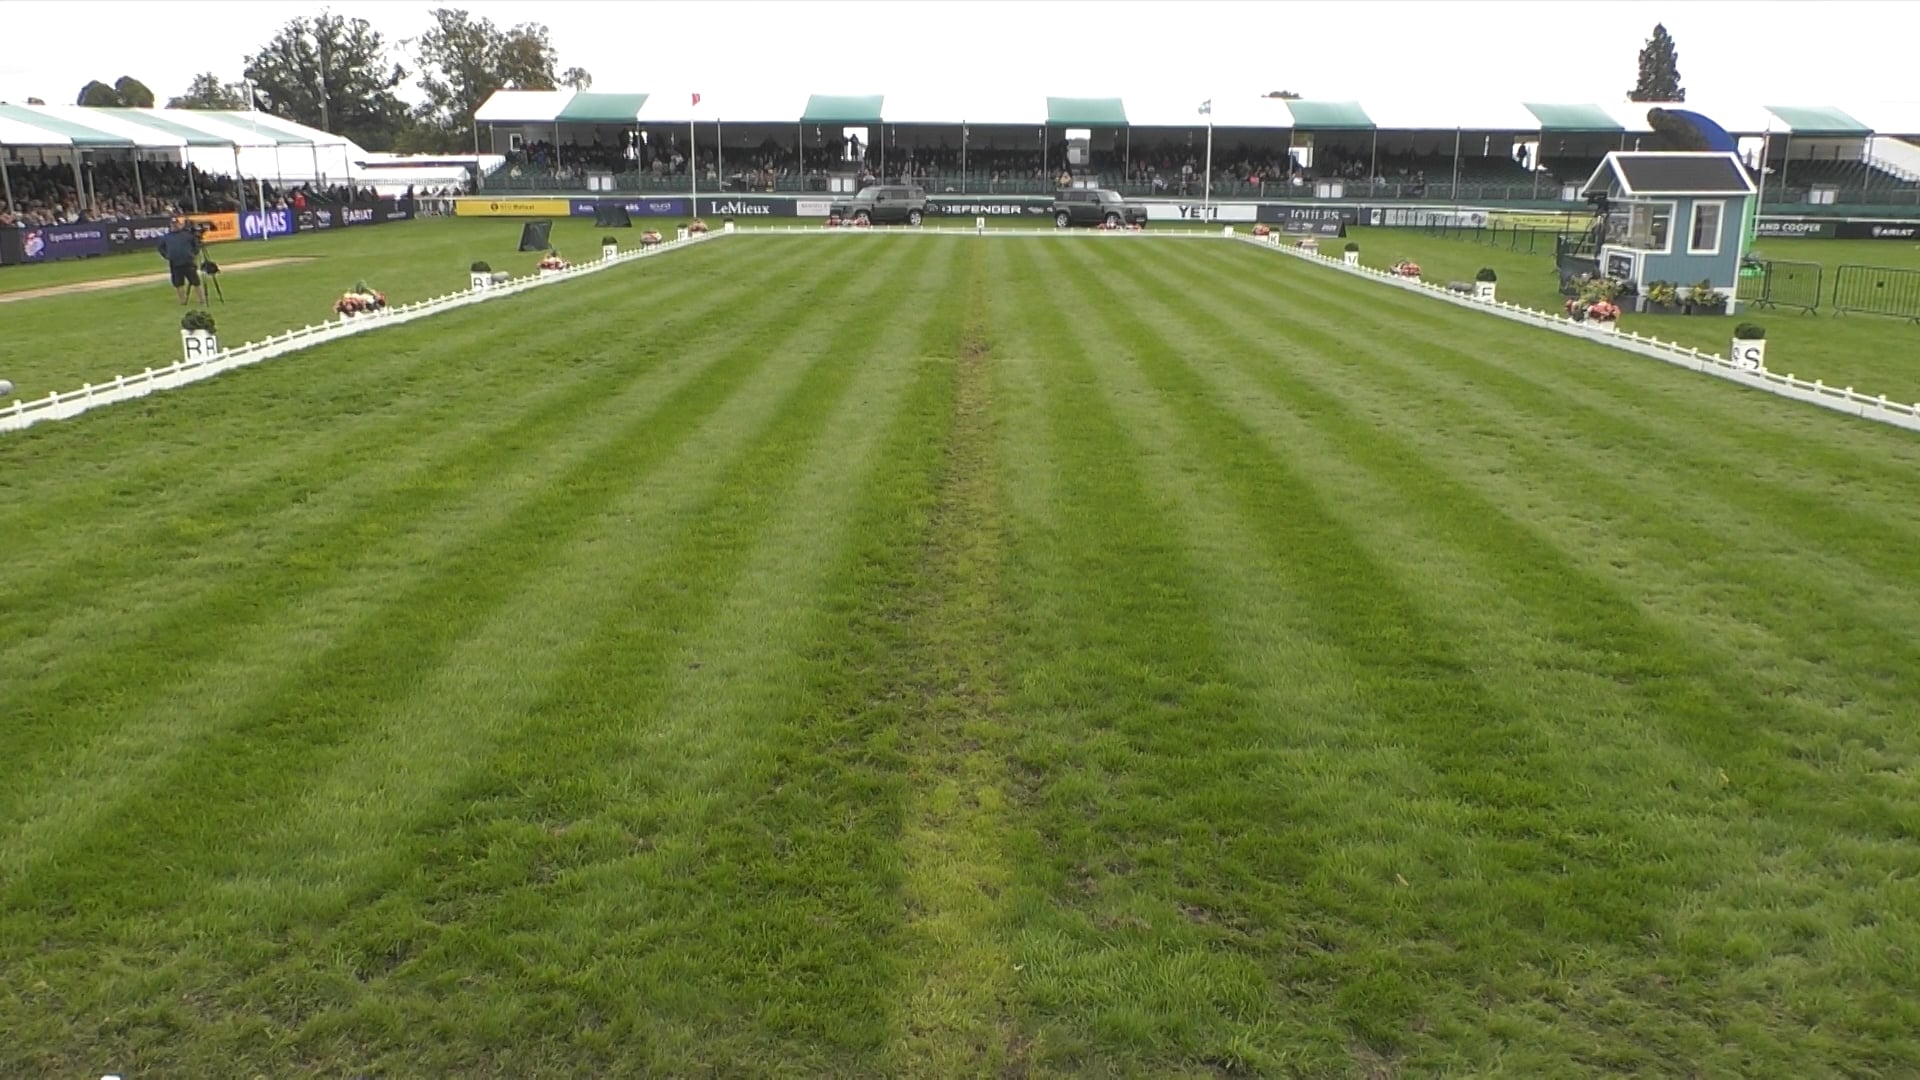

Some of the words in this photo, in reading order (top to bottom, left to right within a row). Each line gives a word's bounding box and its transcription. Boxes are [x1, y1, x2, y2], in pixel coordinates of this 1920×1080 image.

[711, 201, 770, 214] LeMieux
[942, 205, 1021, 214] DEFENDER
[1179, 206, 1218, 218] YETI
[349, 209, 373, 222] ARIAT
[255, 211, 288, 234] MARS
[1756, 223, 1780, 231] AND
[1744, 347, 1760, 370] S
